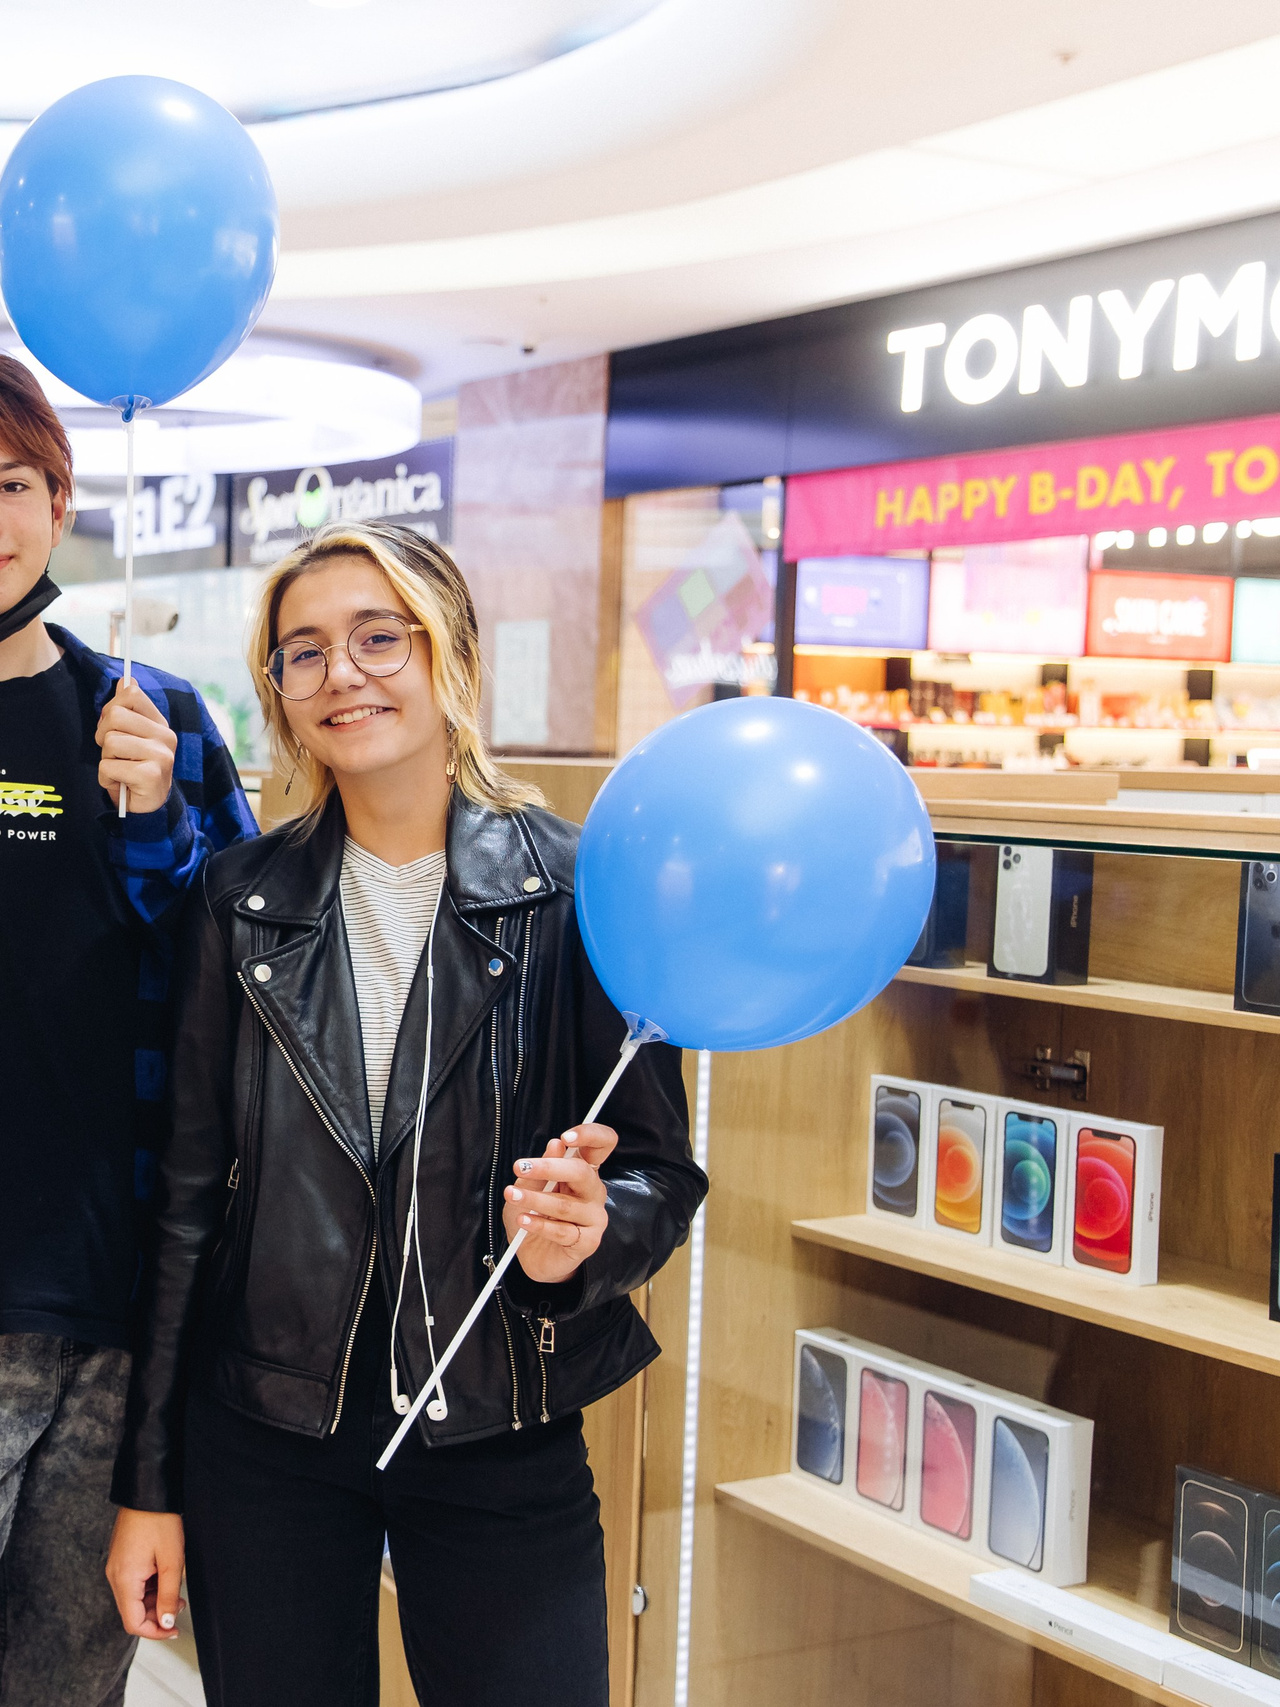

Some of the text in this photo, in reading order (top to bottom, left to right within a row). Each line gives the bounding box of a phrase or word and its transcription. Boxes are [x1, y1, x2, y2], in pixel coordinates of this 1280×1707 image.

[887, 261, 1280, 412] TONYM
[876, 446, 1280, 529] HAPPY B-DAY, TO
[7, 830, 57, 841] POWER
